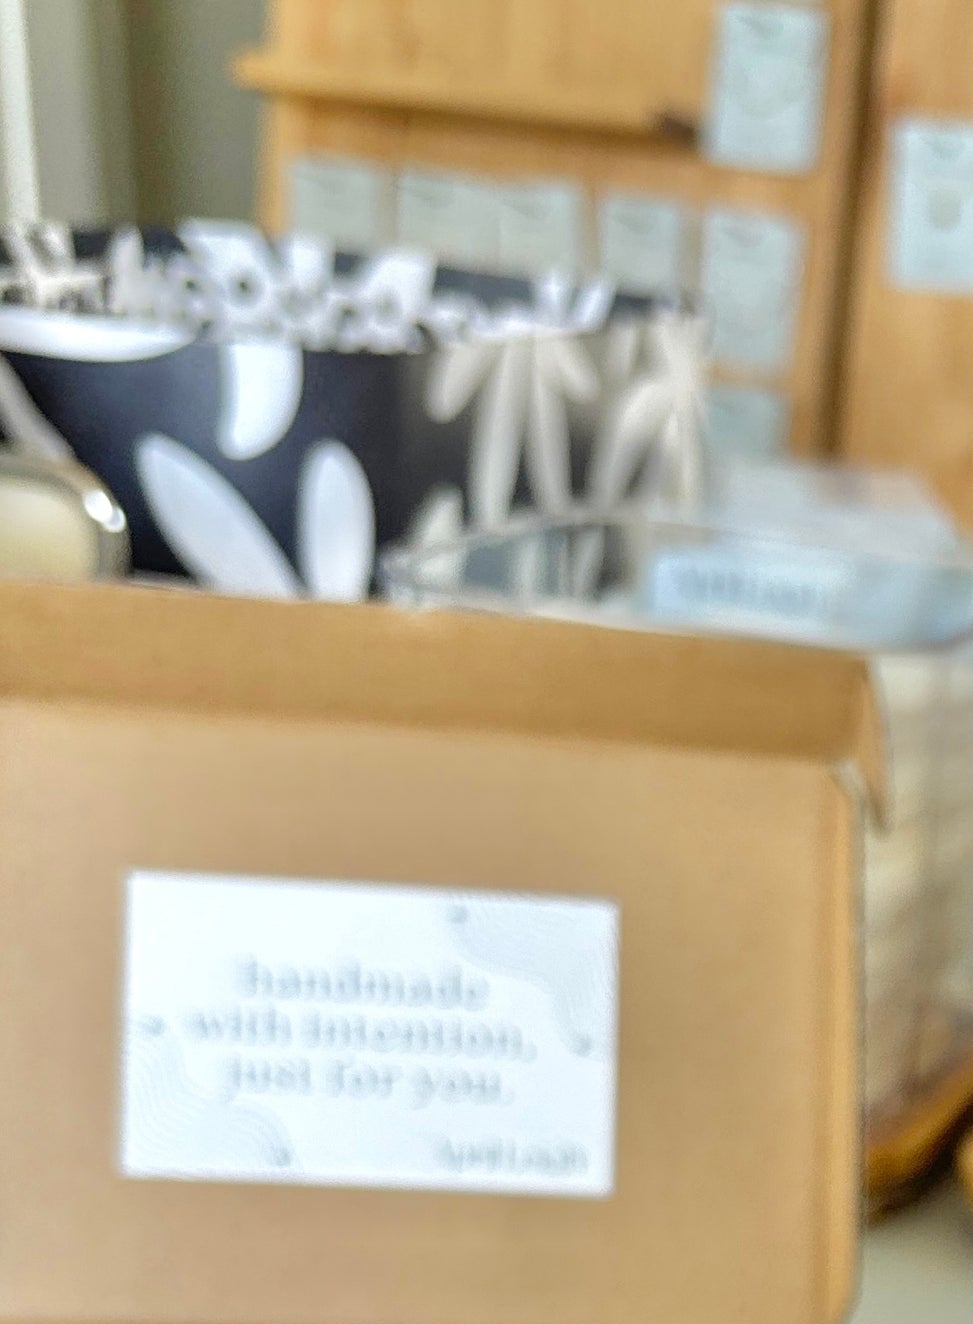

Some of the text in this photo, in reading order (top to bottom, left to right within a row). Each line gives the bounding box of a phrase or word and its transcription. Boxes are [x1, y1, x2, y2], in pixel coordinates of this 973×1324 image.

[235, 955, 489, 1010] handmade
[187, 1003, 293, 1046] with
[326, 1057, 400, 1099] for
